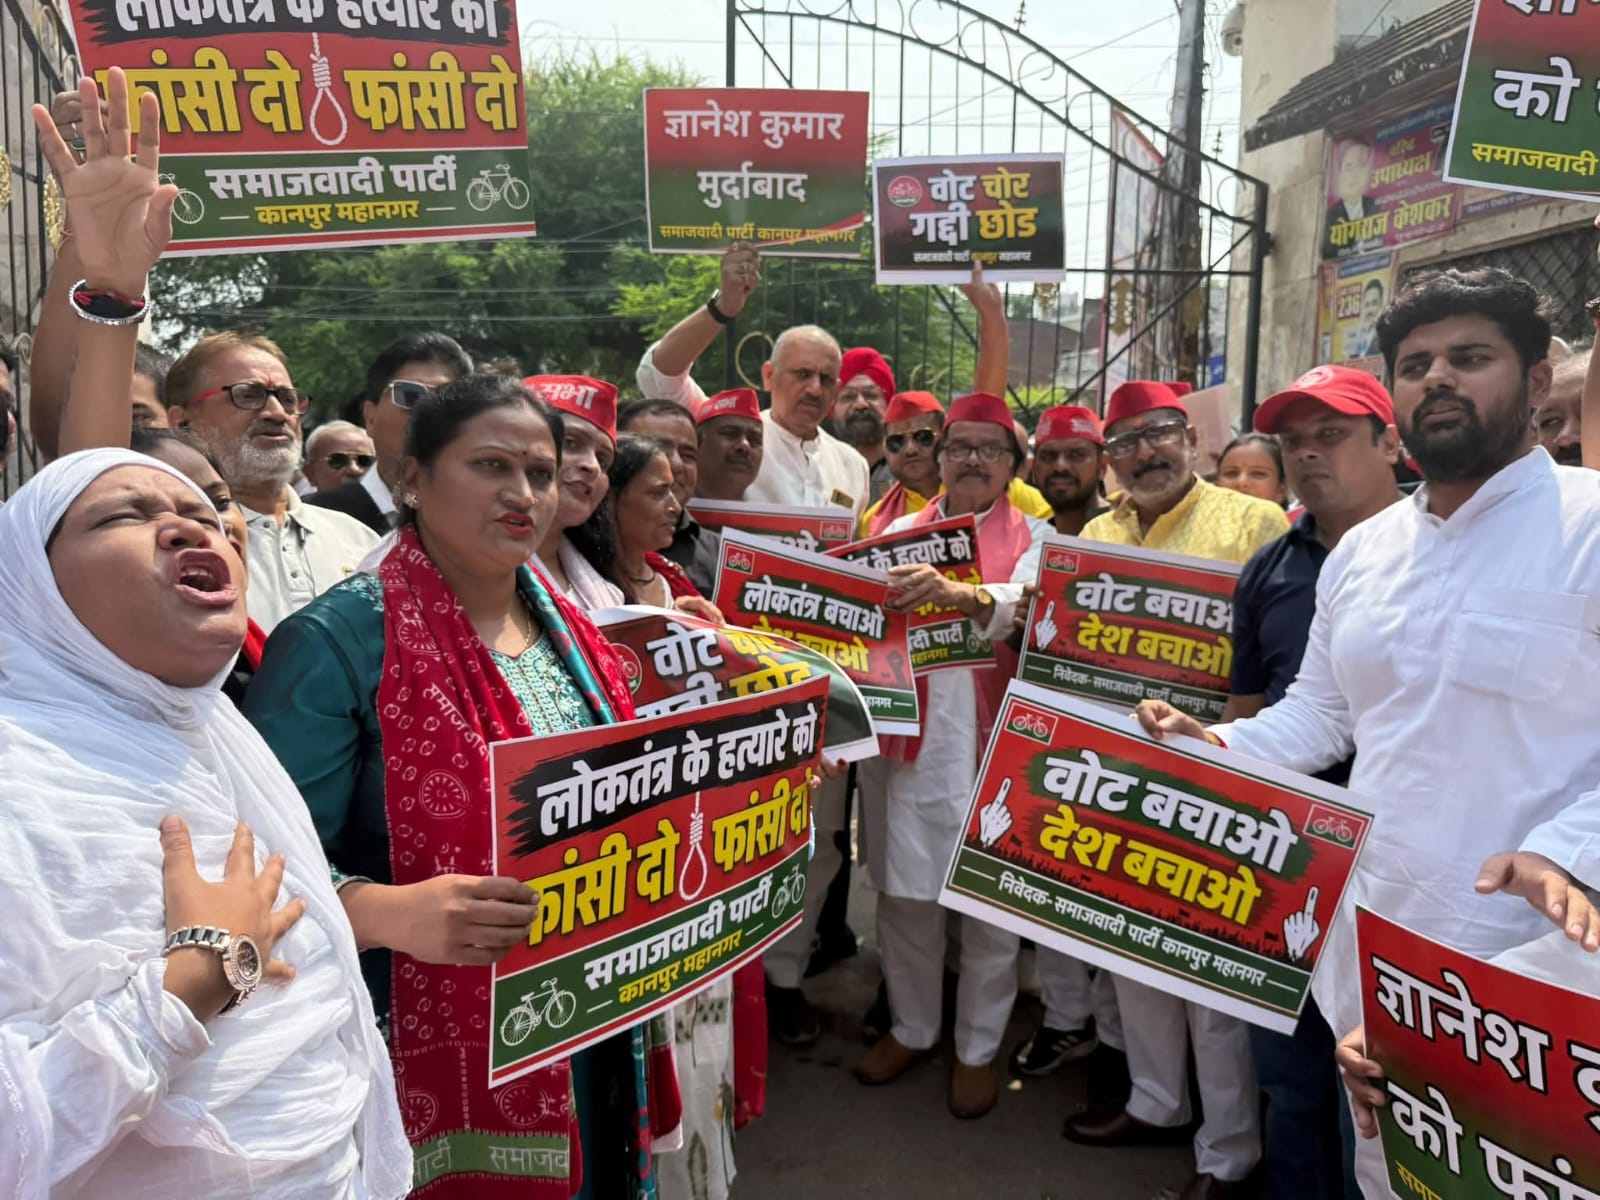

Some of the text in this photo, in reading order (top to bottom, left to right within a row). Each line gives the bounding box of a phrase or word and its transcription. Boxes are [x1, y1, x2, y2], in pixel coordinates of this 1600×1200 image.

[244, 50, 301, 131] दो
[344, 52, 466, 131] फांसी
[470, 52, 518, 130] दो
[1493, 57, 1581, 122] को
[664, 100, 844, 148] ज्ञानेश कुमार
[205, 155, 457, 198] समाजवादी पार्टी
[697, 162, 807, 206] मुर्दाबाद
[928, 166, 1031, 202] वोट चोर
[1472, 143, 1599, 176] समाजवादी
[255, 199, 419, 230] कानपुर महानगर
[659, 222, 723, 239] समाजवादी
[726, 223, 755, 240] पार्टी
[757, 227, 801, 246] कानपुर
[909, 202, 972, 246] गद्दी
[950, 530, 972, 562] को
[744, 575, 821, 620] लोकतंत्र
[823, 604, 886, 639] बचाओ
[1075, 572, 1141, 613] वोट
[645, 621, 724, 677] वोट
[932, 622, 964, 645] पार्टी
[1077, 612, 1234, 679] देश बचाओ
[1092, 675, 1145, 698] समाजवादी
[537, 702, 819, 837] लोकतंत्र के हत्यारे को
[1042, 747, 1300, 874] वोट बचाओ
[636, 818, 681, 904] दो
[711, 783, 790, 872] फांसी
[1039, 803, 1261, 926] देश बचाओ
[583, 871, 774, 991] समाजवादी पार्टी
[1054, 896, 1128, 943] समाजवादी
[1128, 918, 1162, 951] पार्टी
[1161, 936, 1211, 972] कानपुर
[1212, 953, 1268, 988] महानगर
[618, 928, 743, 1004] कानपुर महानगर
[1371, 954, 1550, 1092] ज्ञानेश
[1386, 1079, 1464, 1176] को
